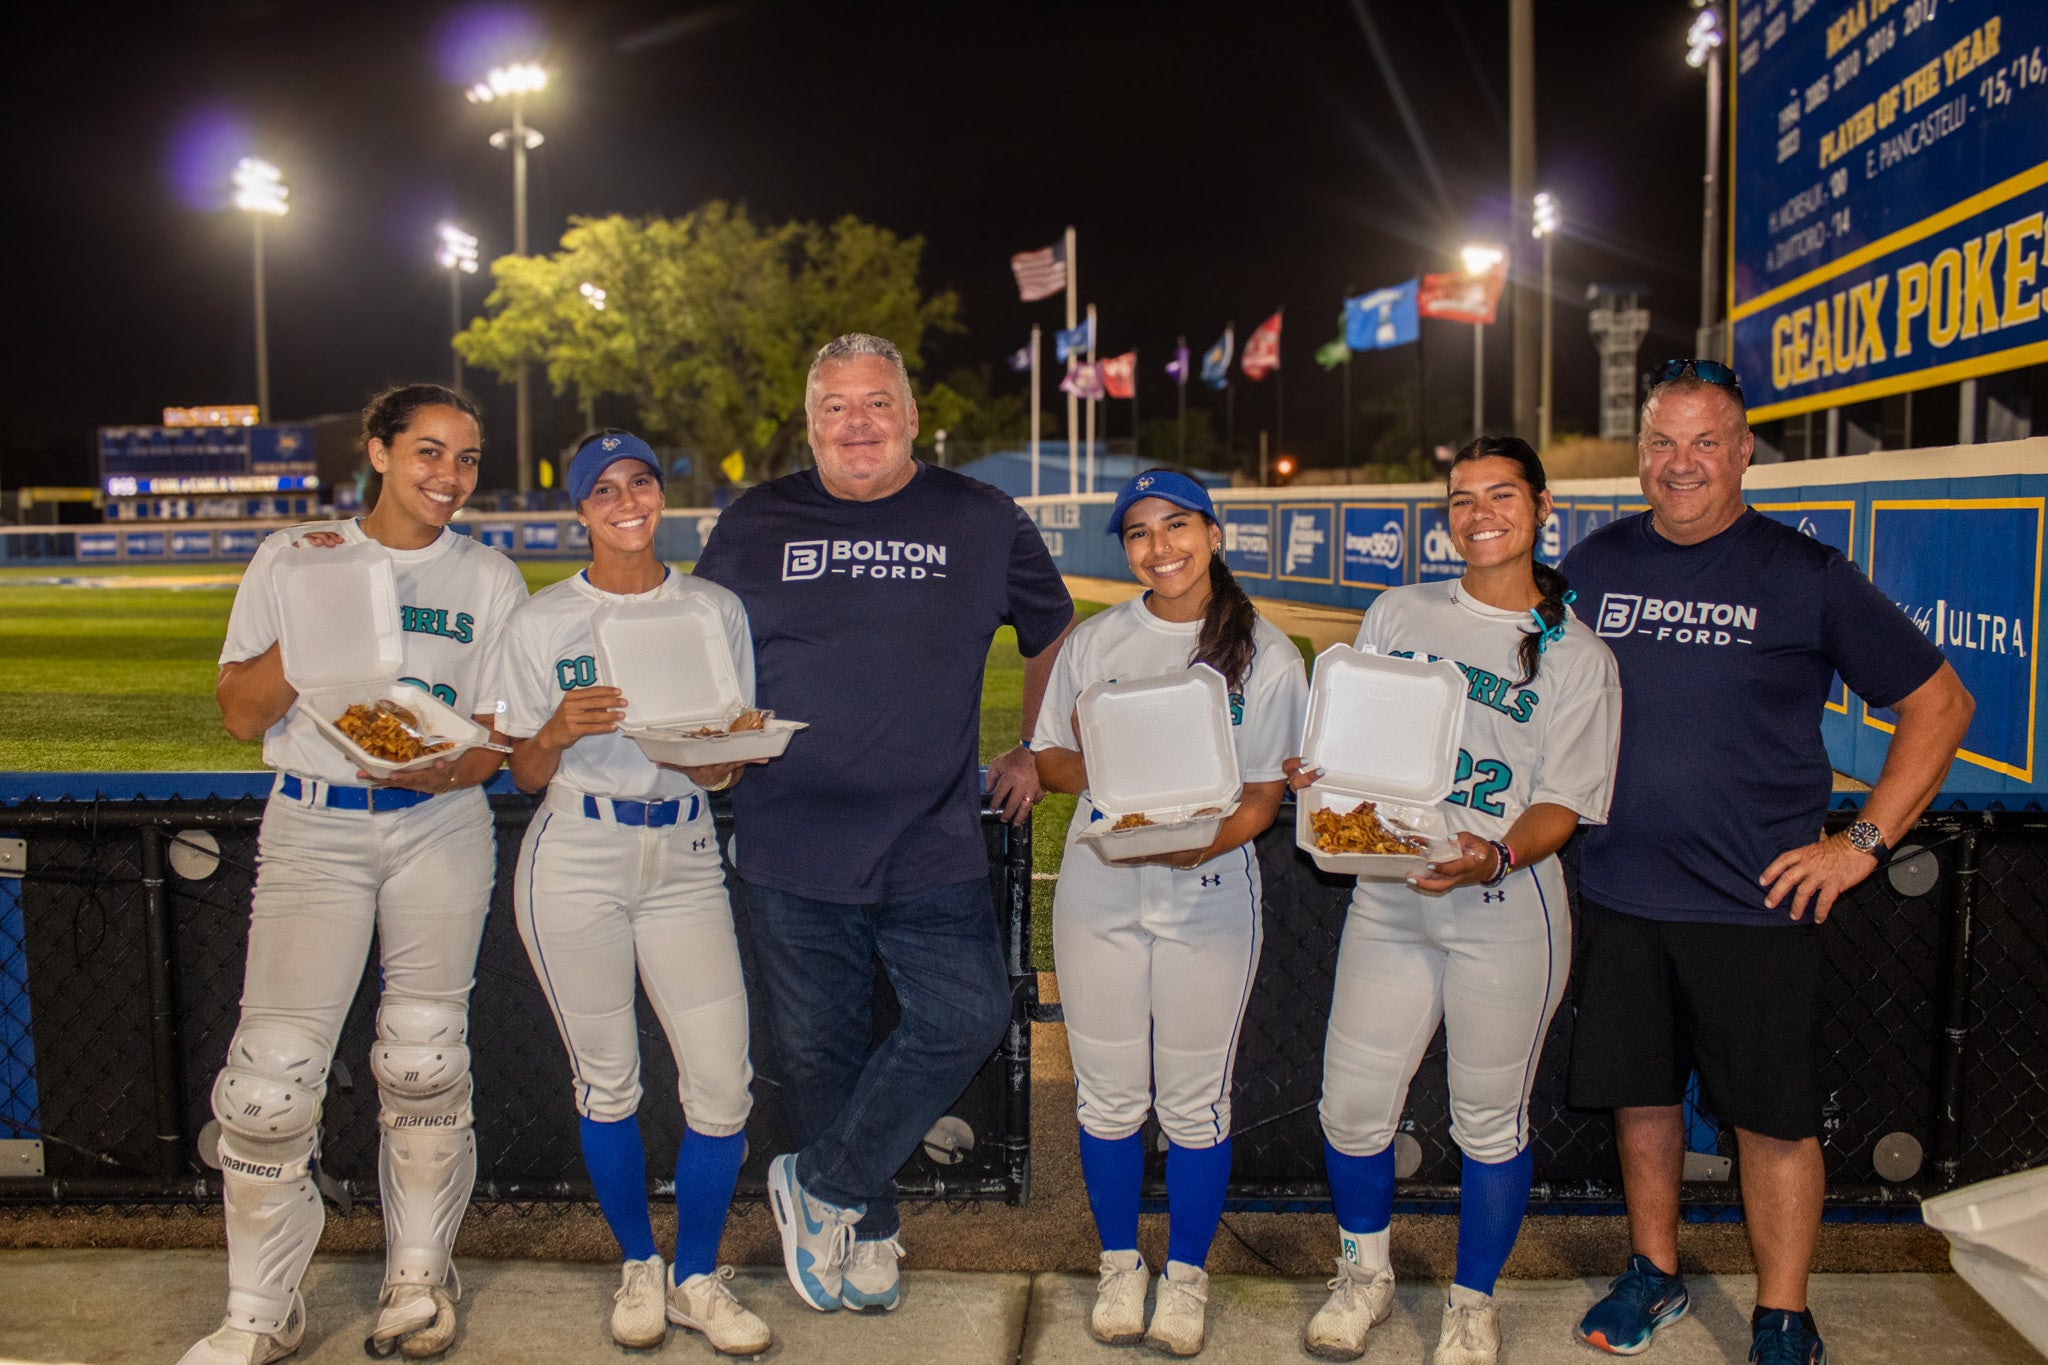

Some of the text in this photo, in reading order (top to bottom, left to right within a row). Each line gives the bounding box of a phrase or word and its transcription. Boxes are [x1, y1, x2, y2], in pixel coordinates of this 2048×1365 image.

[1819, 16, 2001, 170] PLAYER OF THE YEAR
[1771, 211, 2048, 391] GEAUX POKE
[832, 540, 947, 565] BOLTON
[852, 565, 927, 579] FORD
[401, 605, 474, 644] IRLS
[1642, 598, 1757, 630] BOLTON
[1657, 627, 1732, 645] FORD
[1950, 609, 2026, 658] ULTRA
[1443, 747, 1513, 819] 22
[394, 1112, 458, 1128] marucci
[1823, 1117, 1840, 1129] 41
[220, 1154, 284, 1179] marucci
